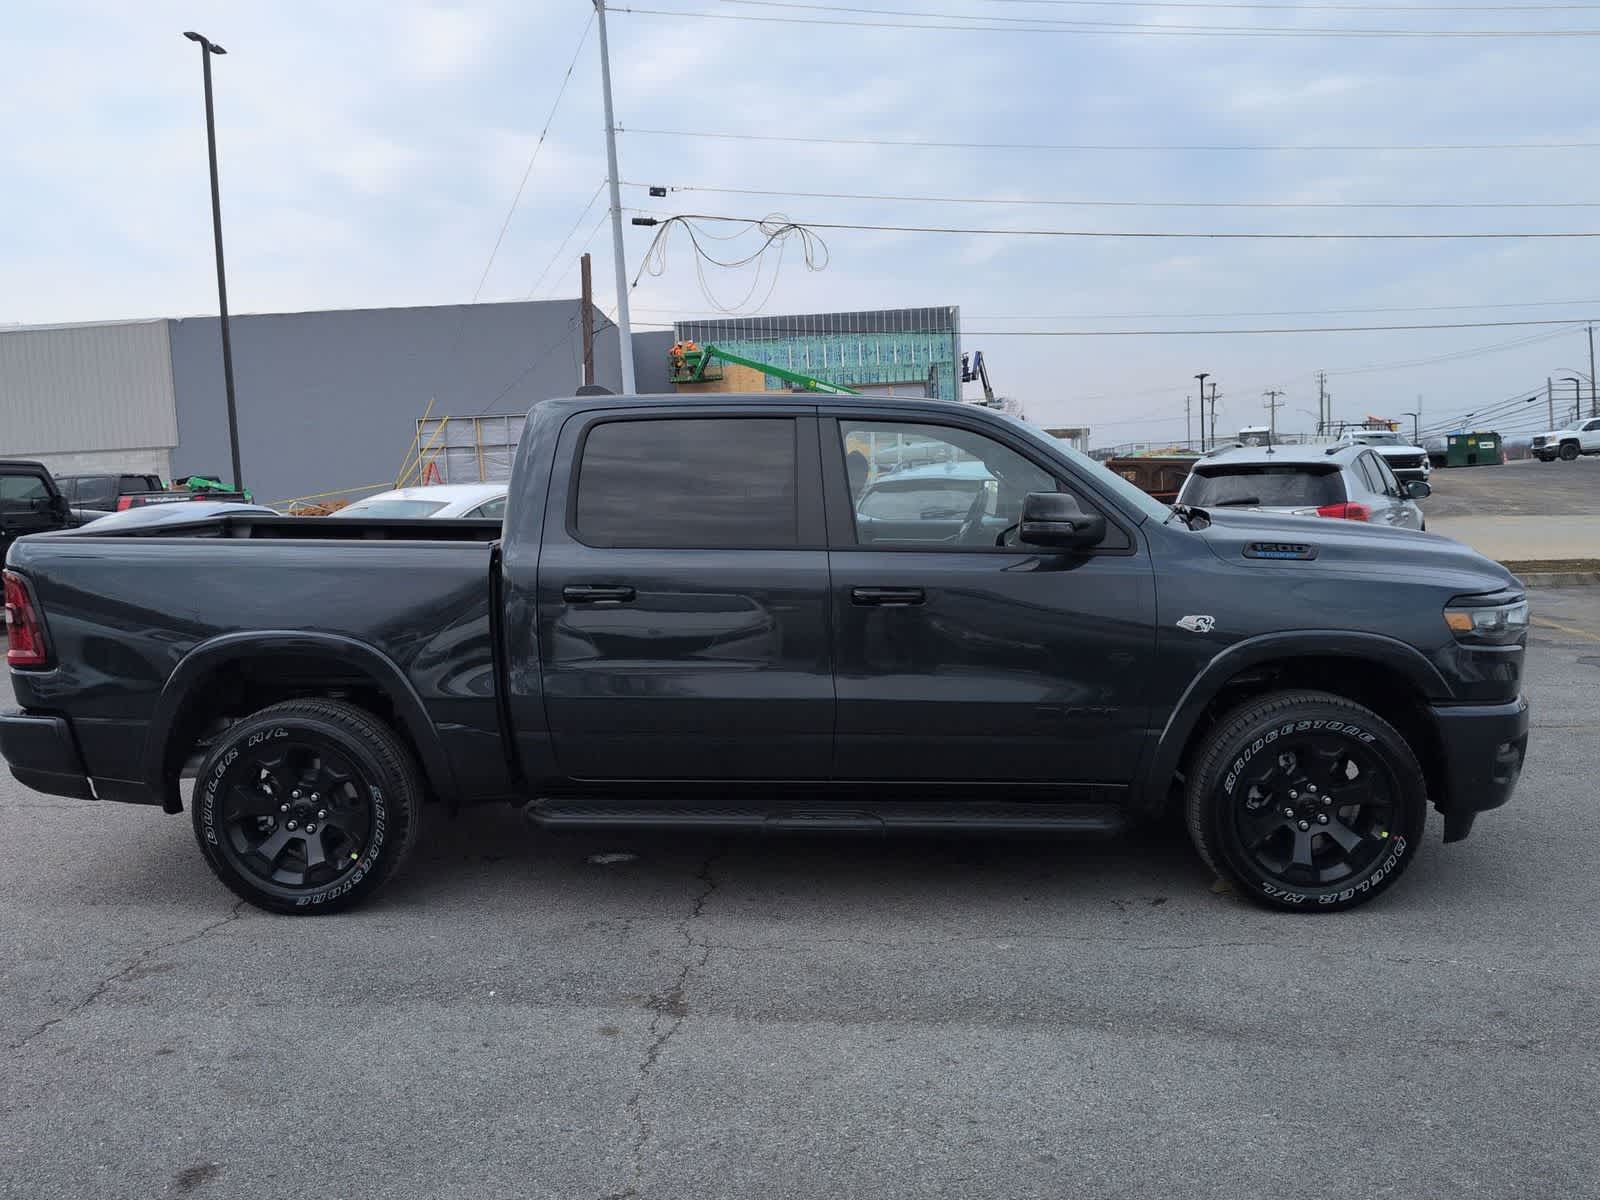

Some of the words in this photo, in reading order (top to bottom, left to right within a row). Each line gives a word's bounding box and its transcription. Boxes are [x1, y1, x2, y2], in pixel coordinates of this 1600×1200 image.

[201, 749, 239, 846] DUELER
[1224, 719, 1376, 794] BRIDGESTONE
[296, 785, 385, 906] BRIDGESTONE
[1319, 836, 1406, 904] DUELER
